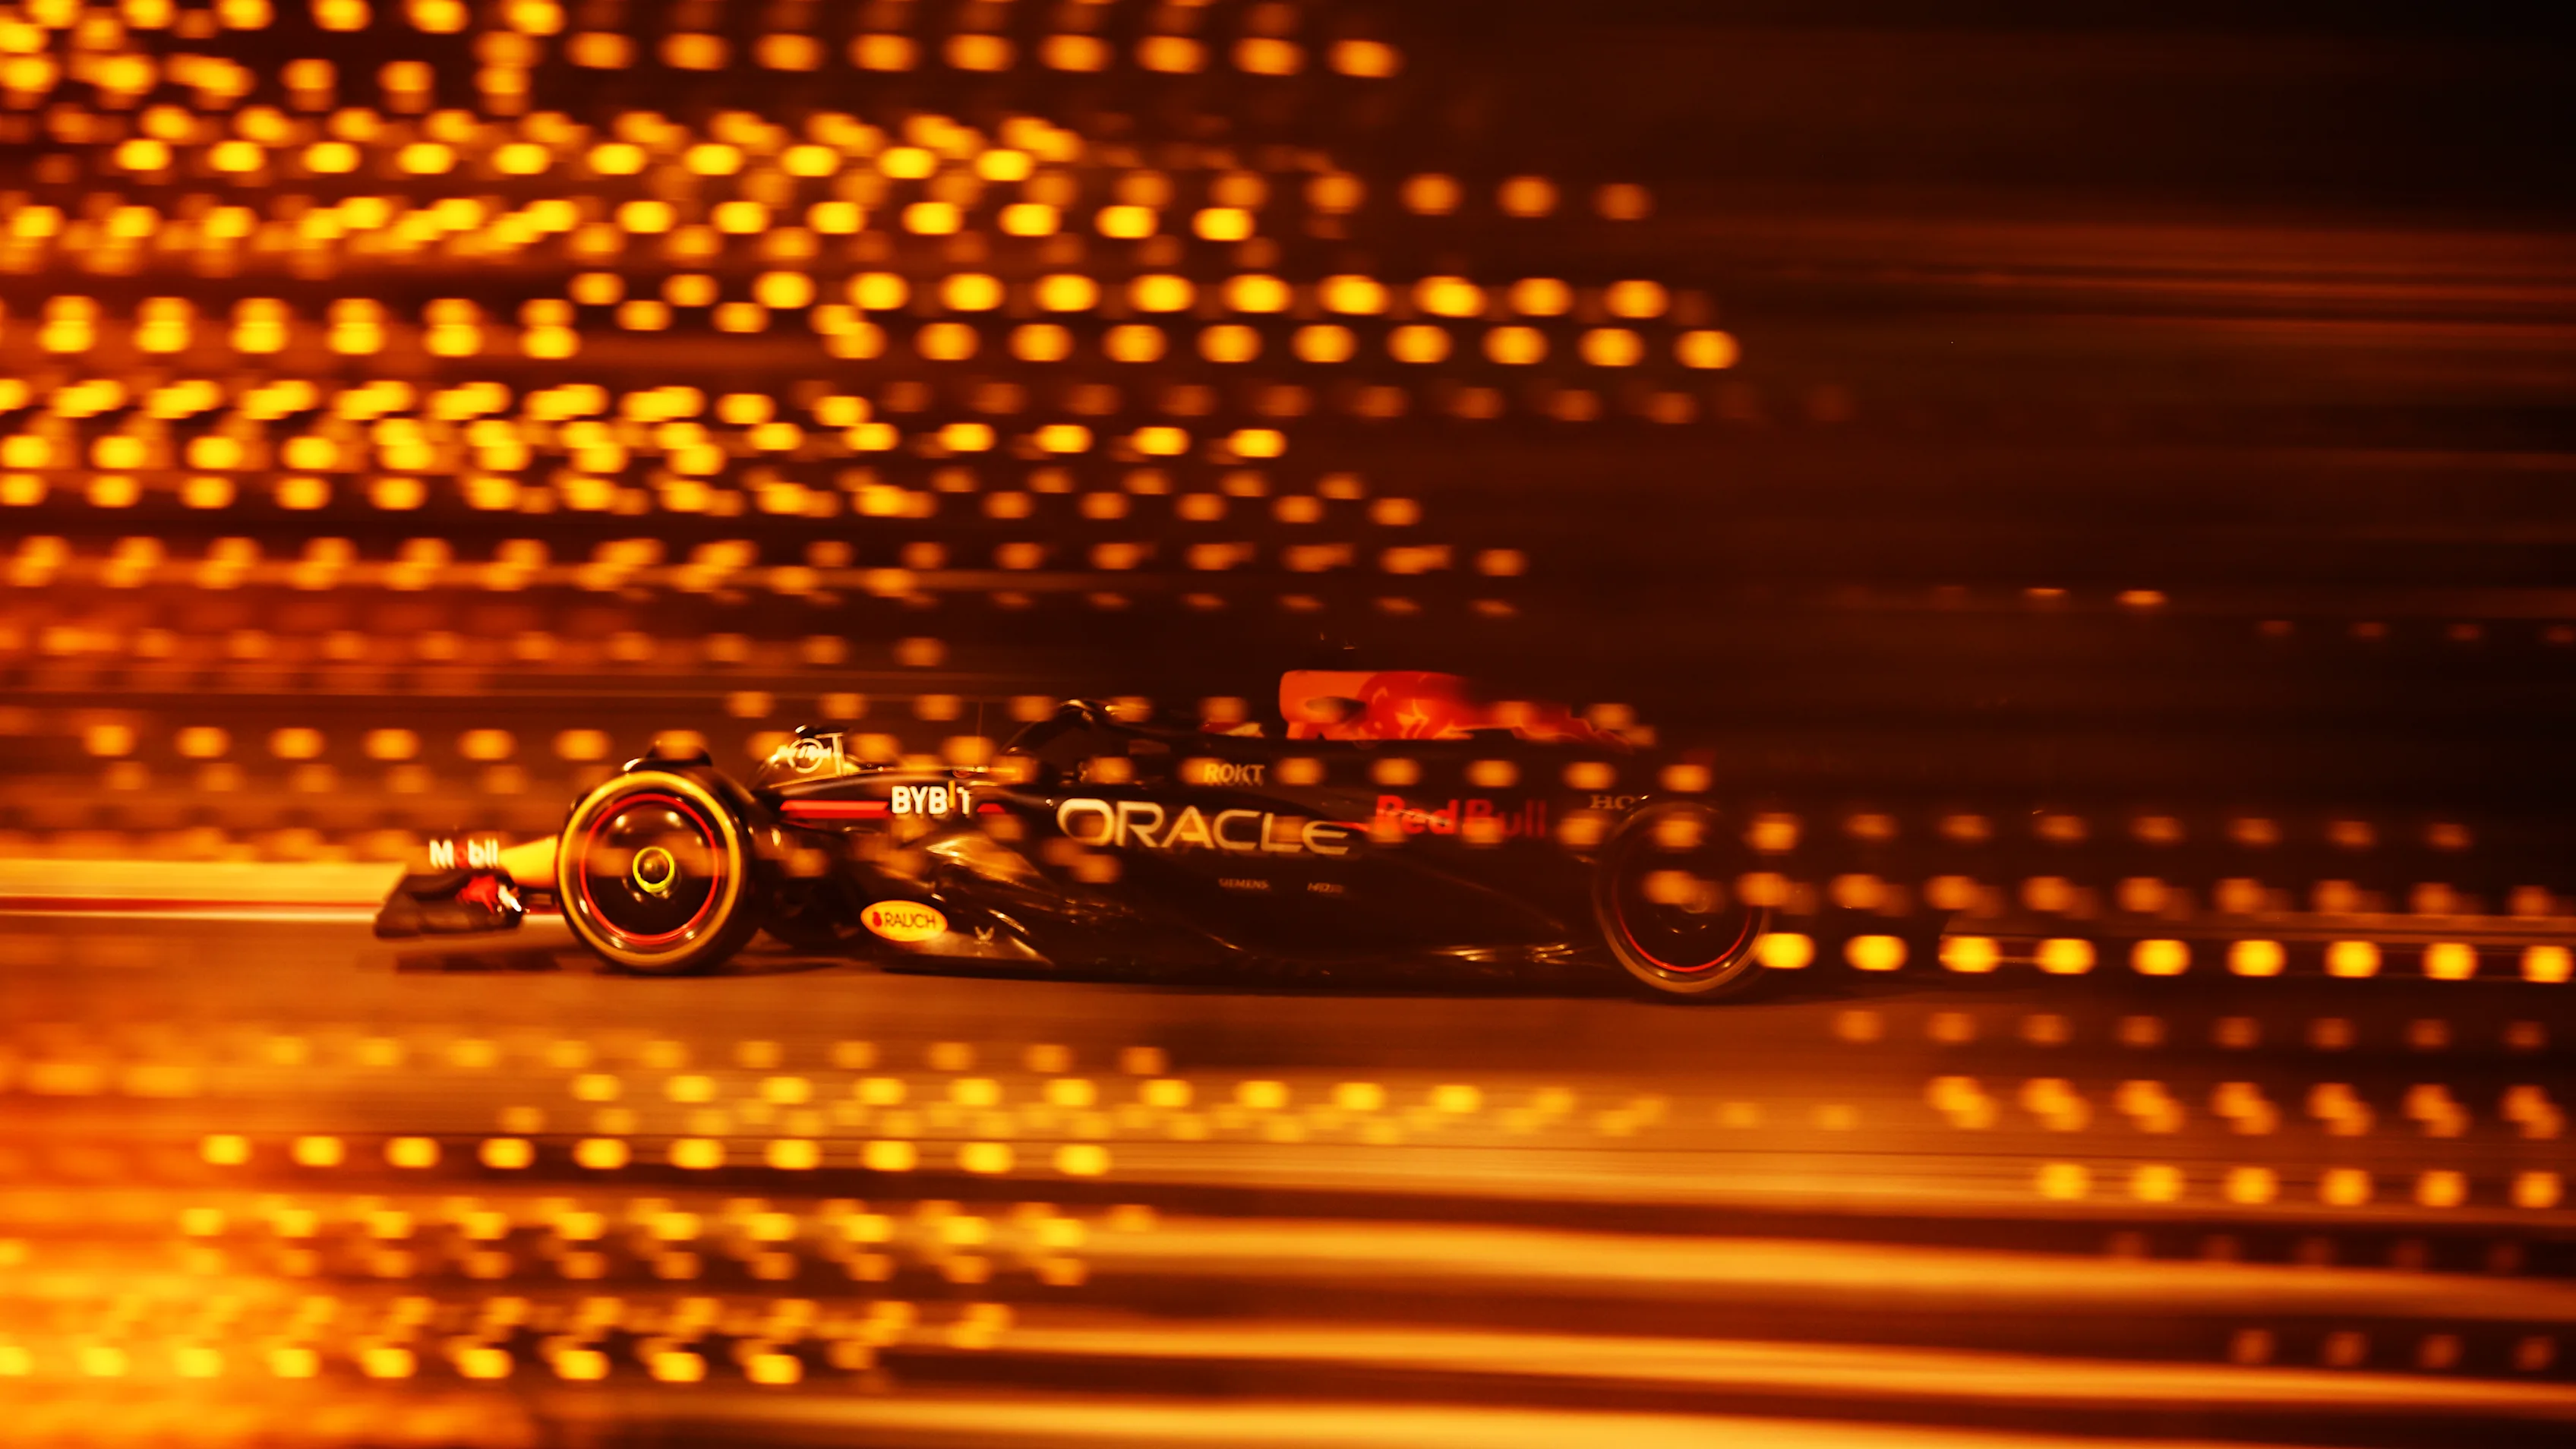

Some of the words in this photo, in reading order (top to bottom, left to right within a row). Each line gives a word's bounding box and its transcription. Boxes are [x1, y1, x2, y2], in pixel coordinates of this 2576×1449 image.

[1203, 763, 1265, 785] ROKT
[892, 780, 971, 814] BYBIT
[1589, 794, 1635, 810] HO
[1056, 798, 1350, 855] ORACLE
[1375, 795, 1459, 835] Red
[1465, 800, 1547, 838] Bull
[429, 838, 499, 869] Mobil
[884, 913, 936, 928] RAUCH
